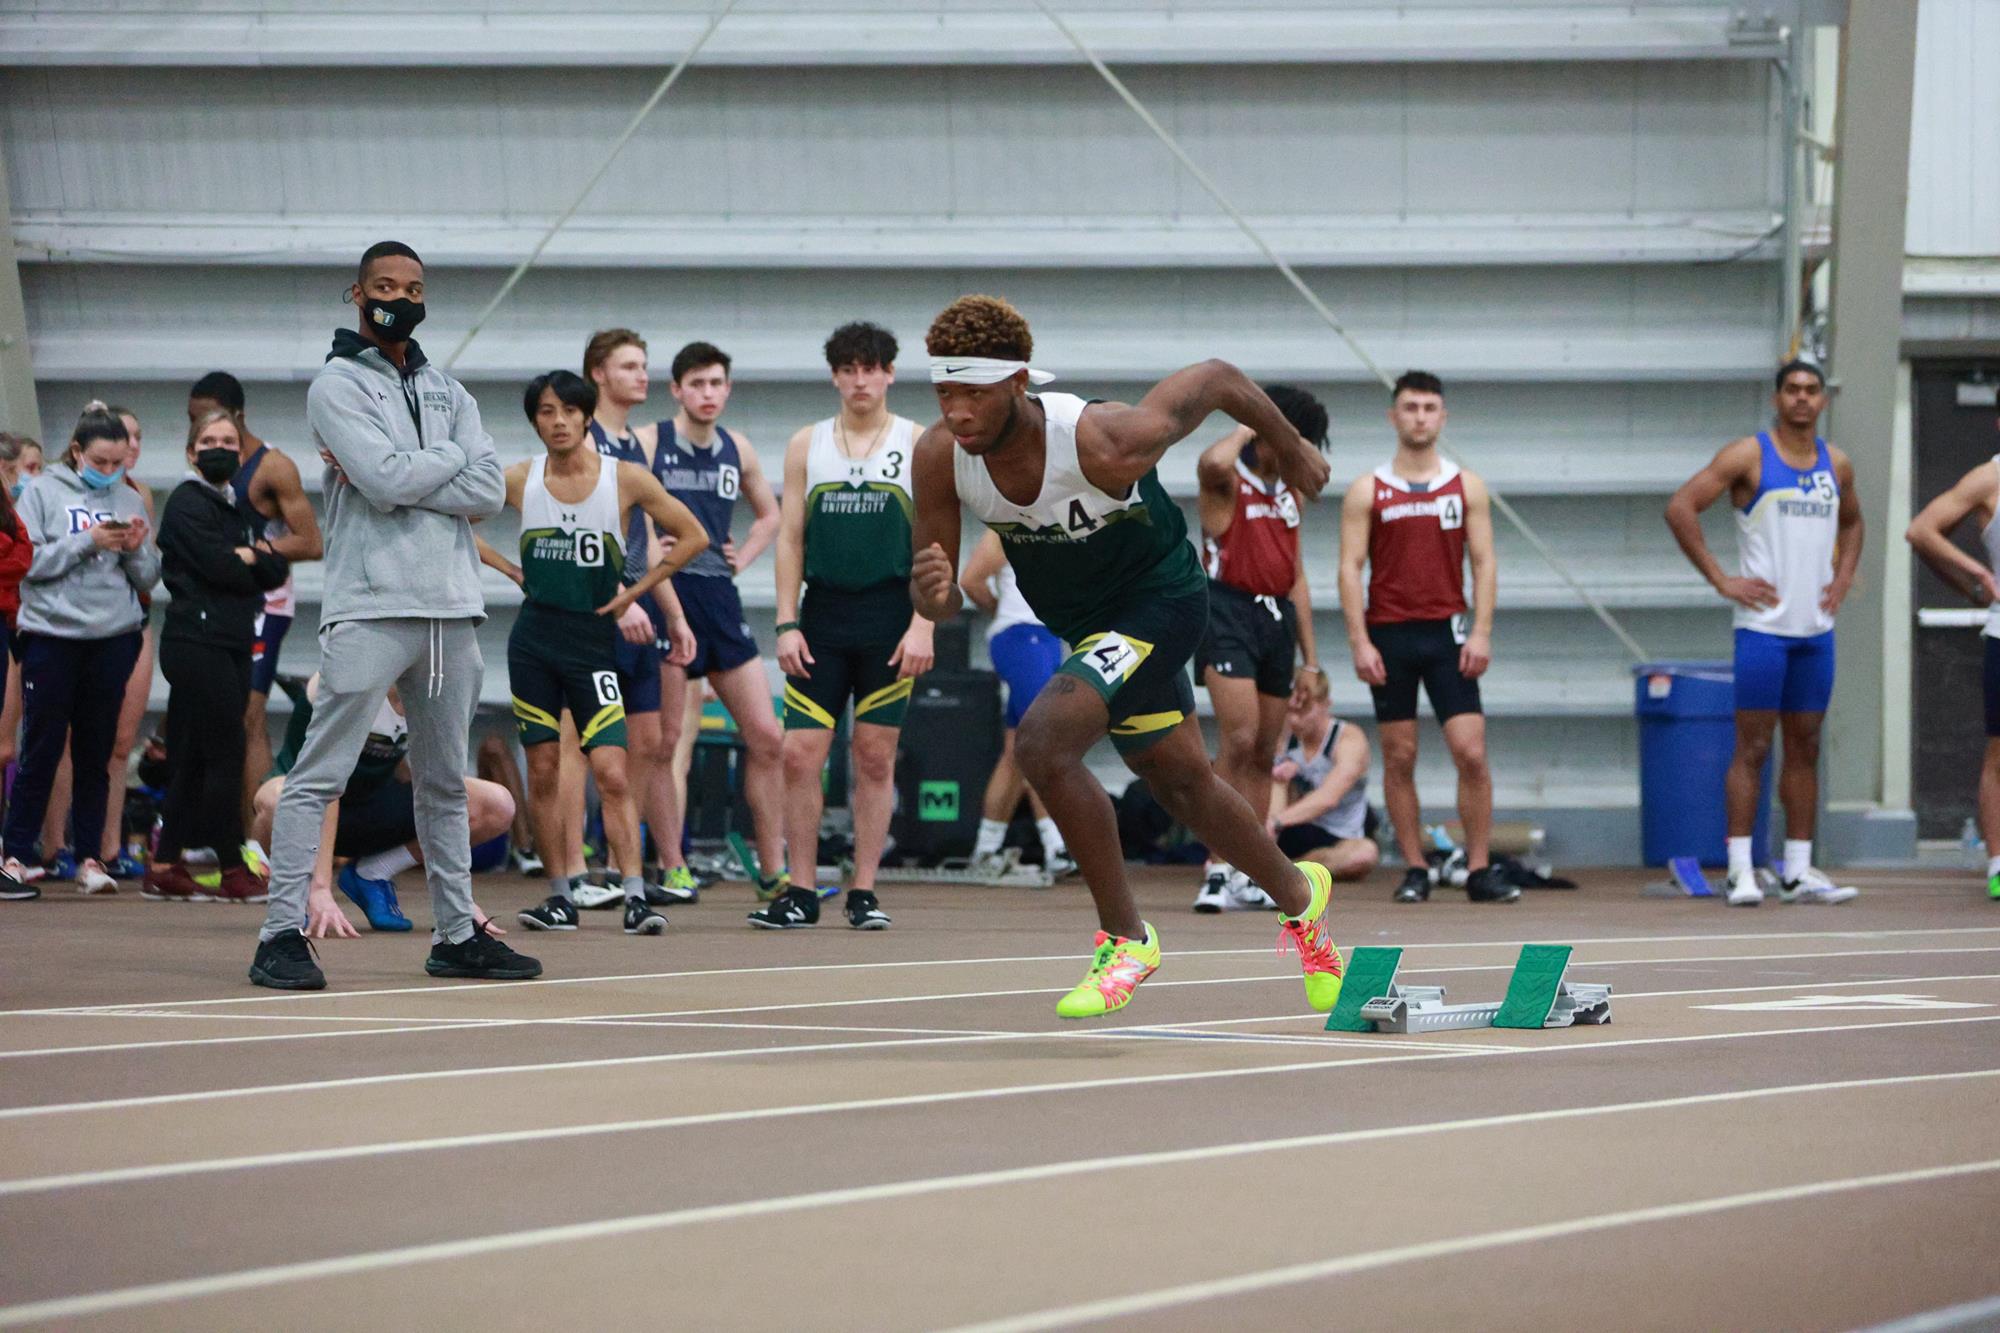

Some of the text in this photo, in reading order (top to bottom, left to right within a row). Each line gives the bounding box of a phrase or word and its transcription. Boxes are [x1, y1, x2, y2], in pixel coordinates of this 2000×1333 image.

[882, 450, 904, 479] 3
[723, 469, 735, 496] 6
[1818, 475, 1834, 501] 5
[821, 502, 886, 513] UNIVERSITY
[1067, 498, 1098, 532] 4
[1445, 499, 1458, 525] 4
[535, 538, 575, 549] DELAWARE
[580, 533, 601, 564] 6
[599, 674, 618, 701] 6
